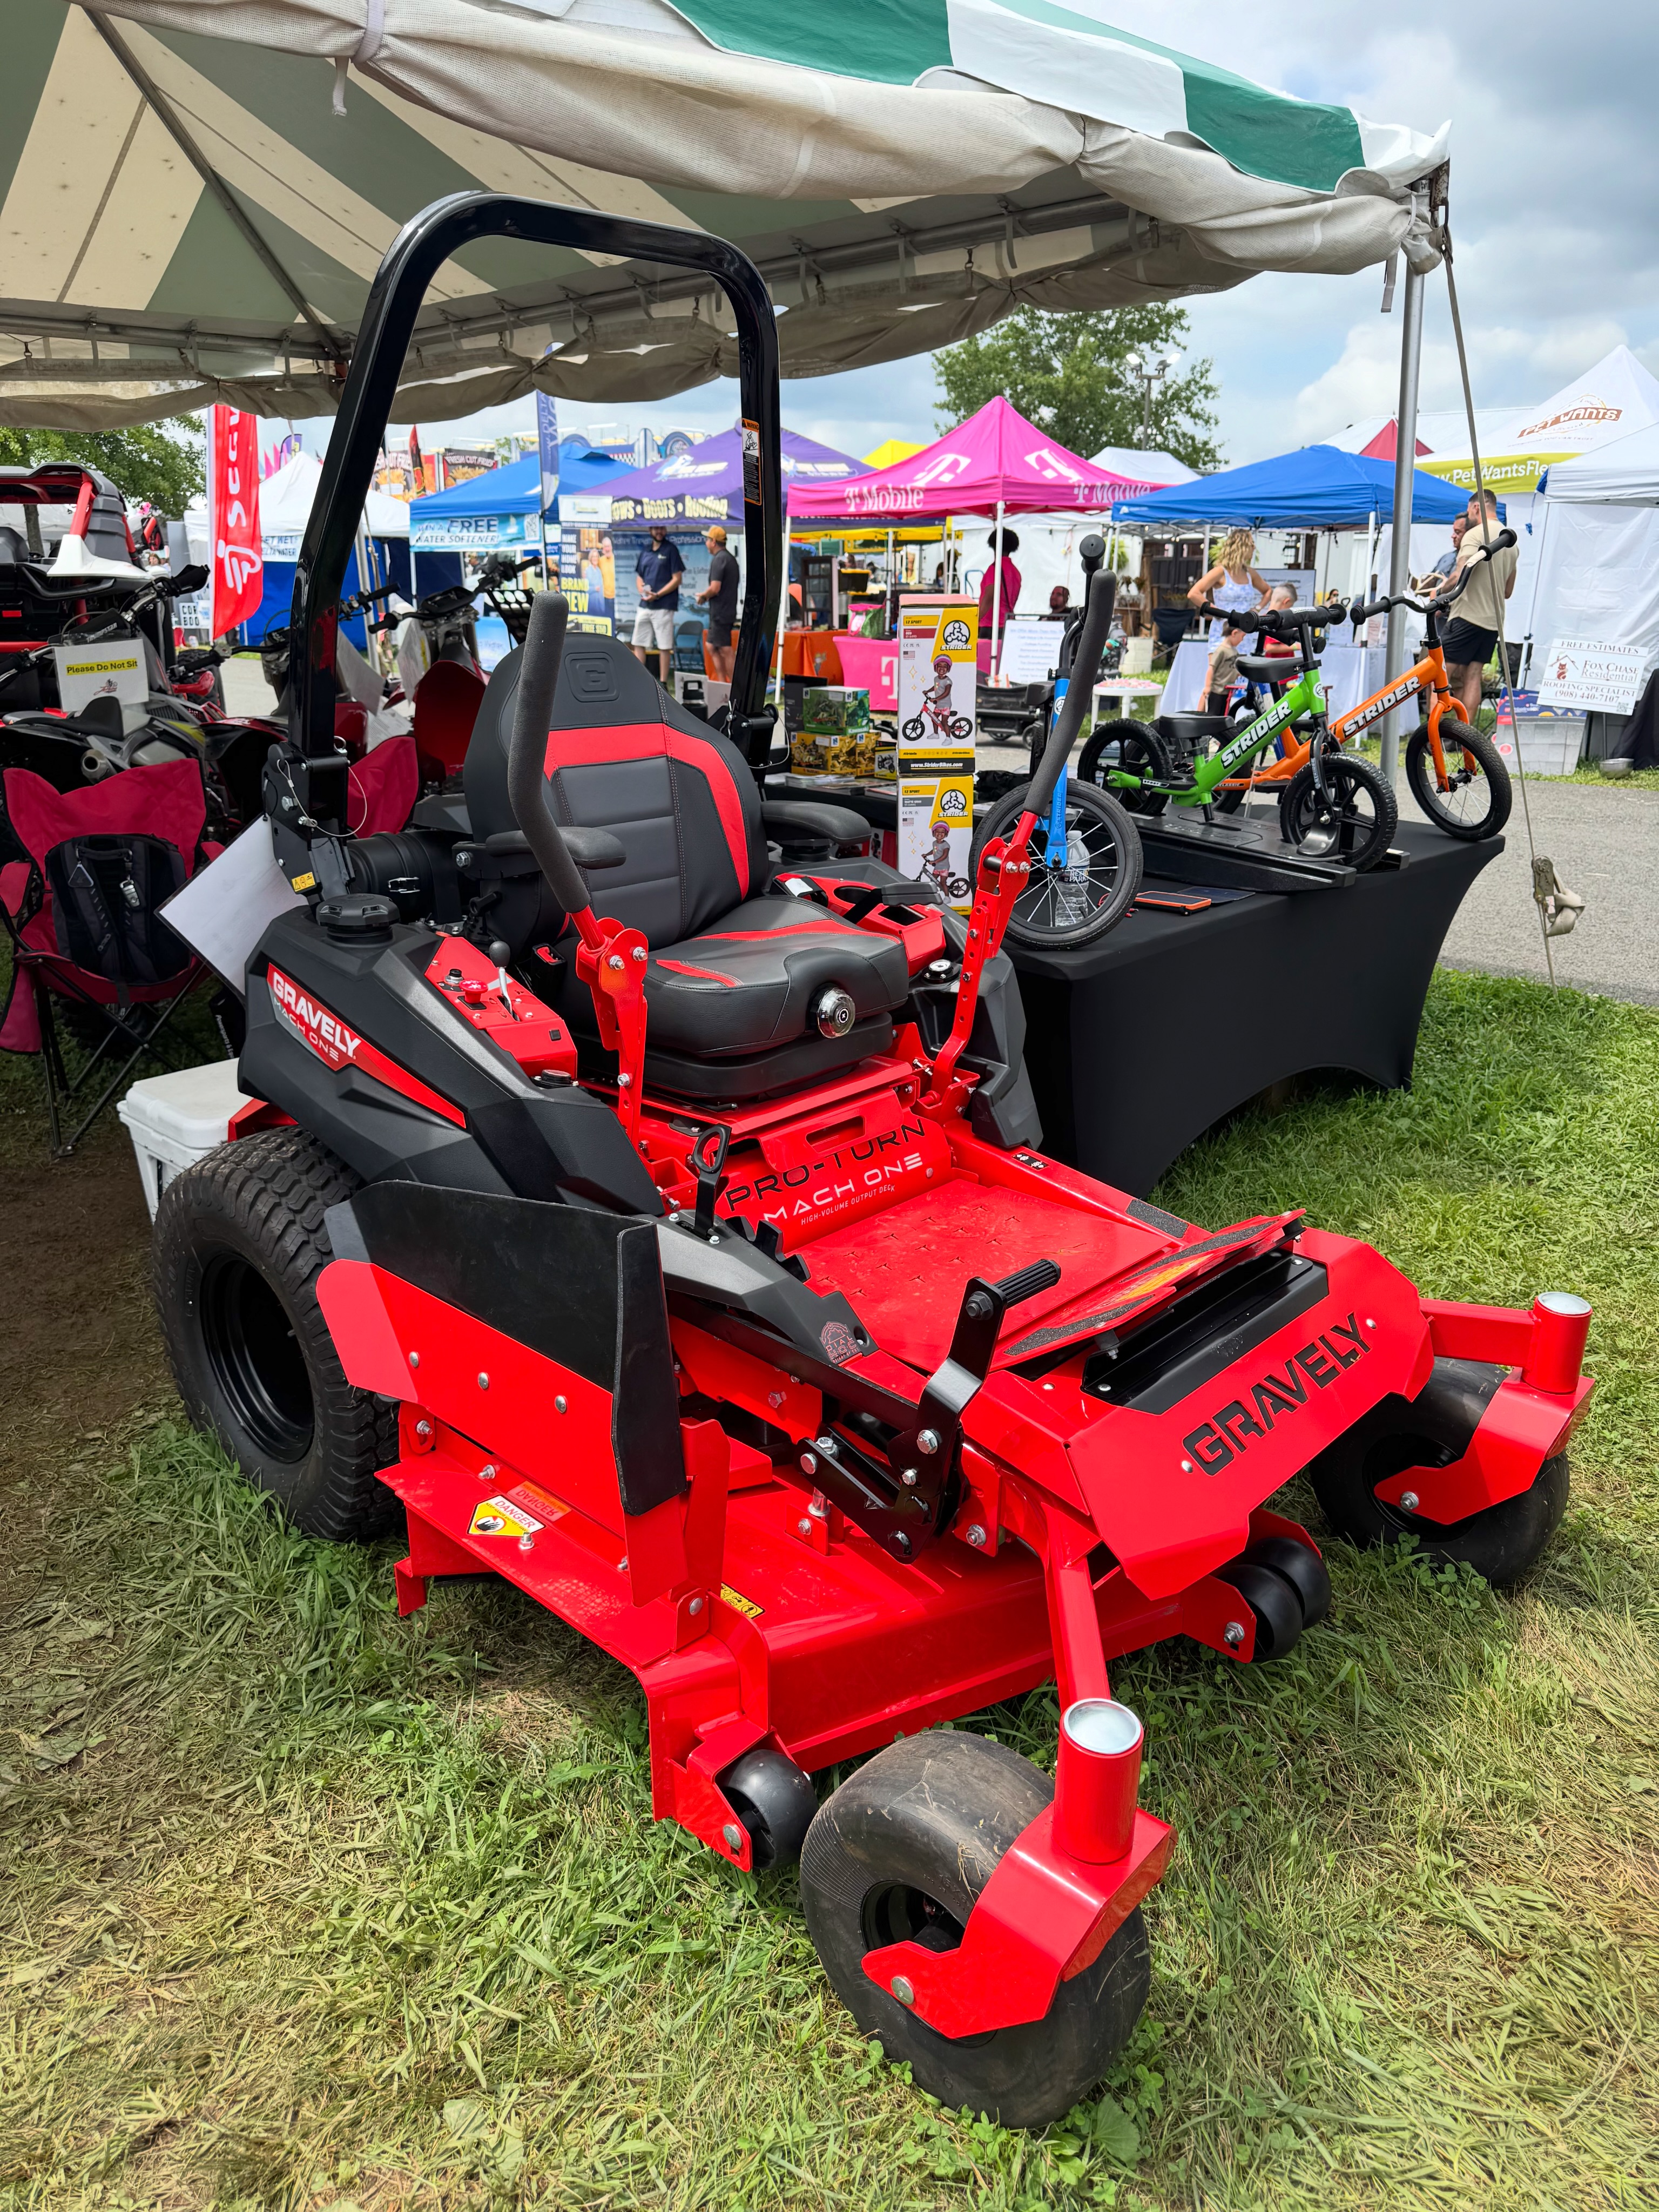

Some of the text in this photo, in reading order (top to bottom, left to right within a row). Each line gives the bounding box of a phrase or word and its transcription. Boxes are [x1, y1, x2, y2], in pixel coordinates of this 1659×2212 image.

[1523, 418, 1555, 436] PET
[447, 517, 499, 534] FREE
[416, 535, 500, 544] WATER SOFTENER!
[561, 577, 589, 591] BRAND
[1561, 640, 1639, 655] FREE ESTIMATES
[66, 664, 95, 674] Please
[110, 662, 125, 670] Not
[126, 660, 138, 669] Sit
[1582, 669, 1638, 683] Residential
[1543, 680, 1637, 697] ROOFING SPECIALIST
[1555, 690, 1620, 703] (908) 440-7107
[1341, 676, 1422, 739] STRIDER
[1220, 700, 1293, 770] STRIDER
[273, 971, 362, 1058] GRAVELY
[274, 997, 339, 1062] MACH ONE
[725, 1118, 926, 1212] PRO-TURN
[763, 1152, 923, 1223] MACH ONE
[801, 1184, 895, 1226] HIGH-VOLUME OUTPUT DECK
[1182, 1312, 1372, 1477] GRAVELY
[495, 1500, 536, 1528] DANGER
